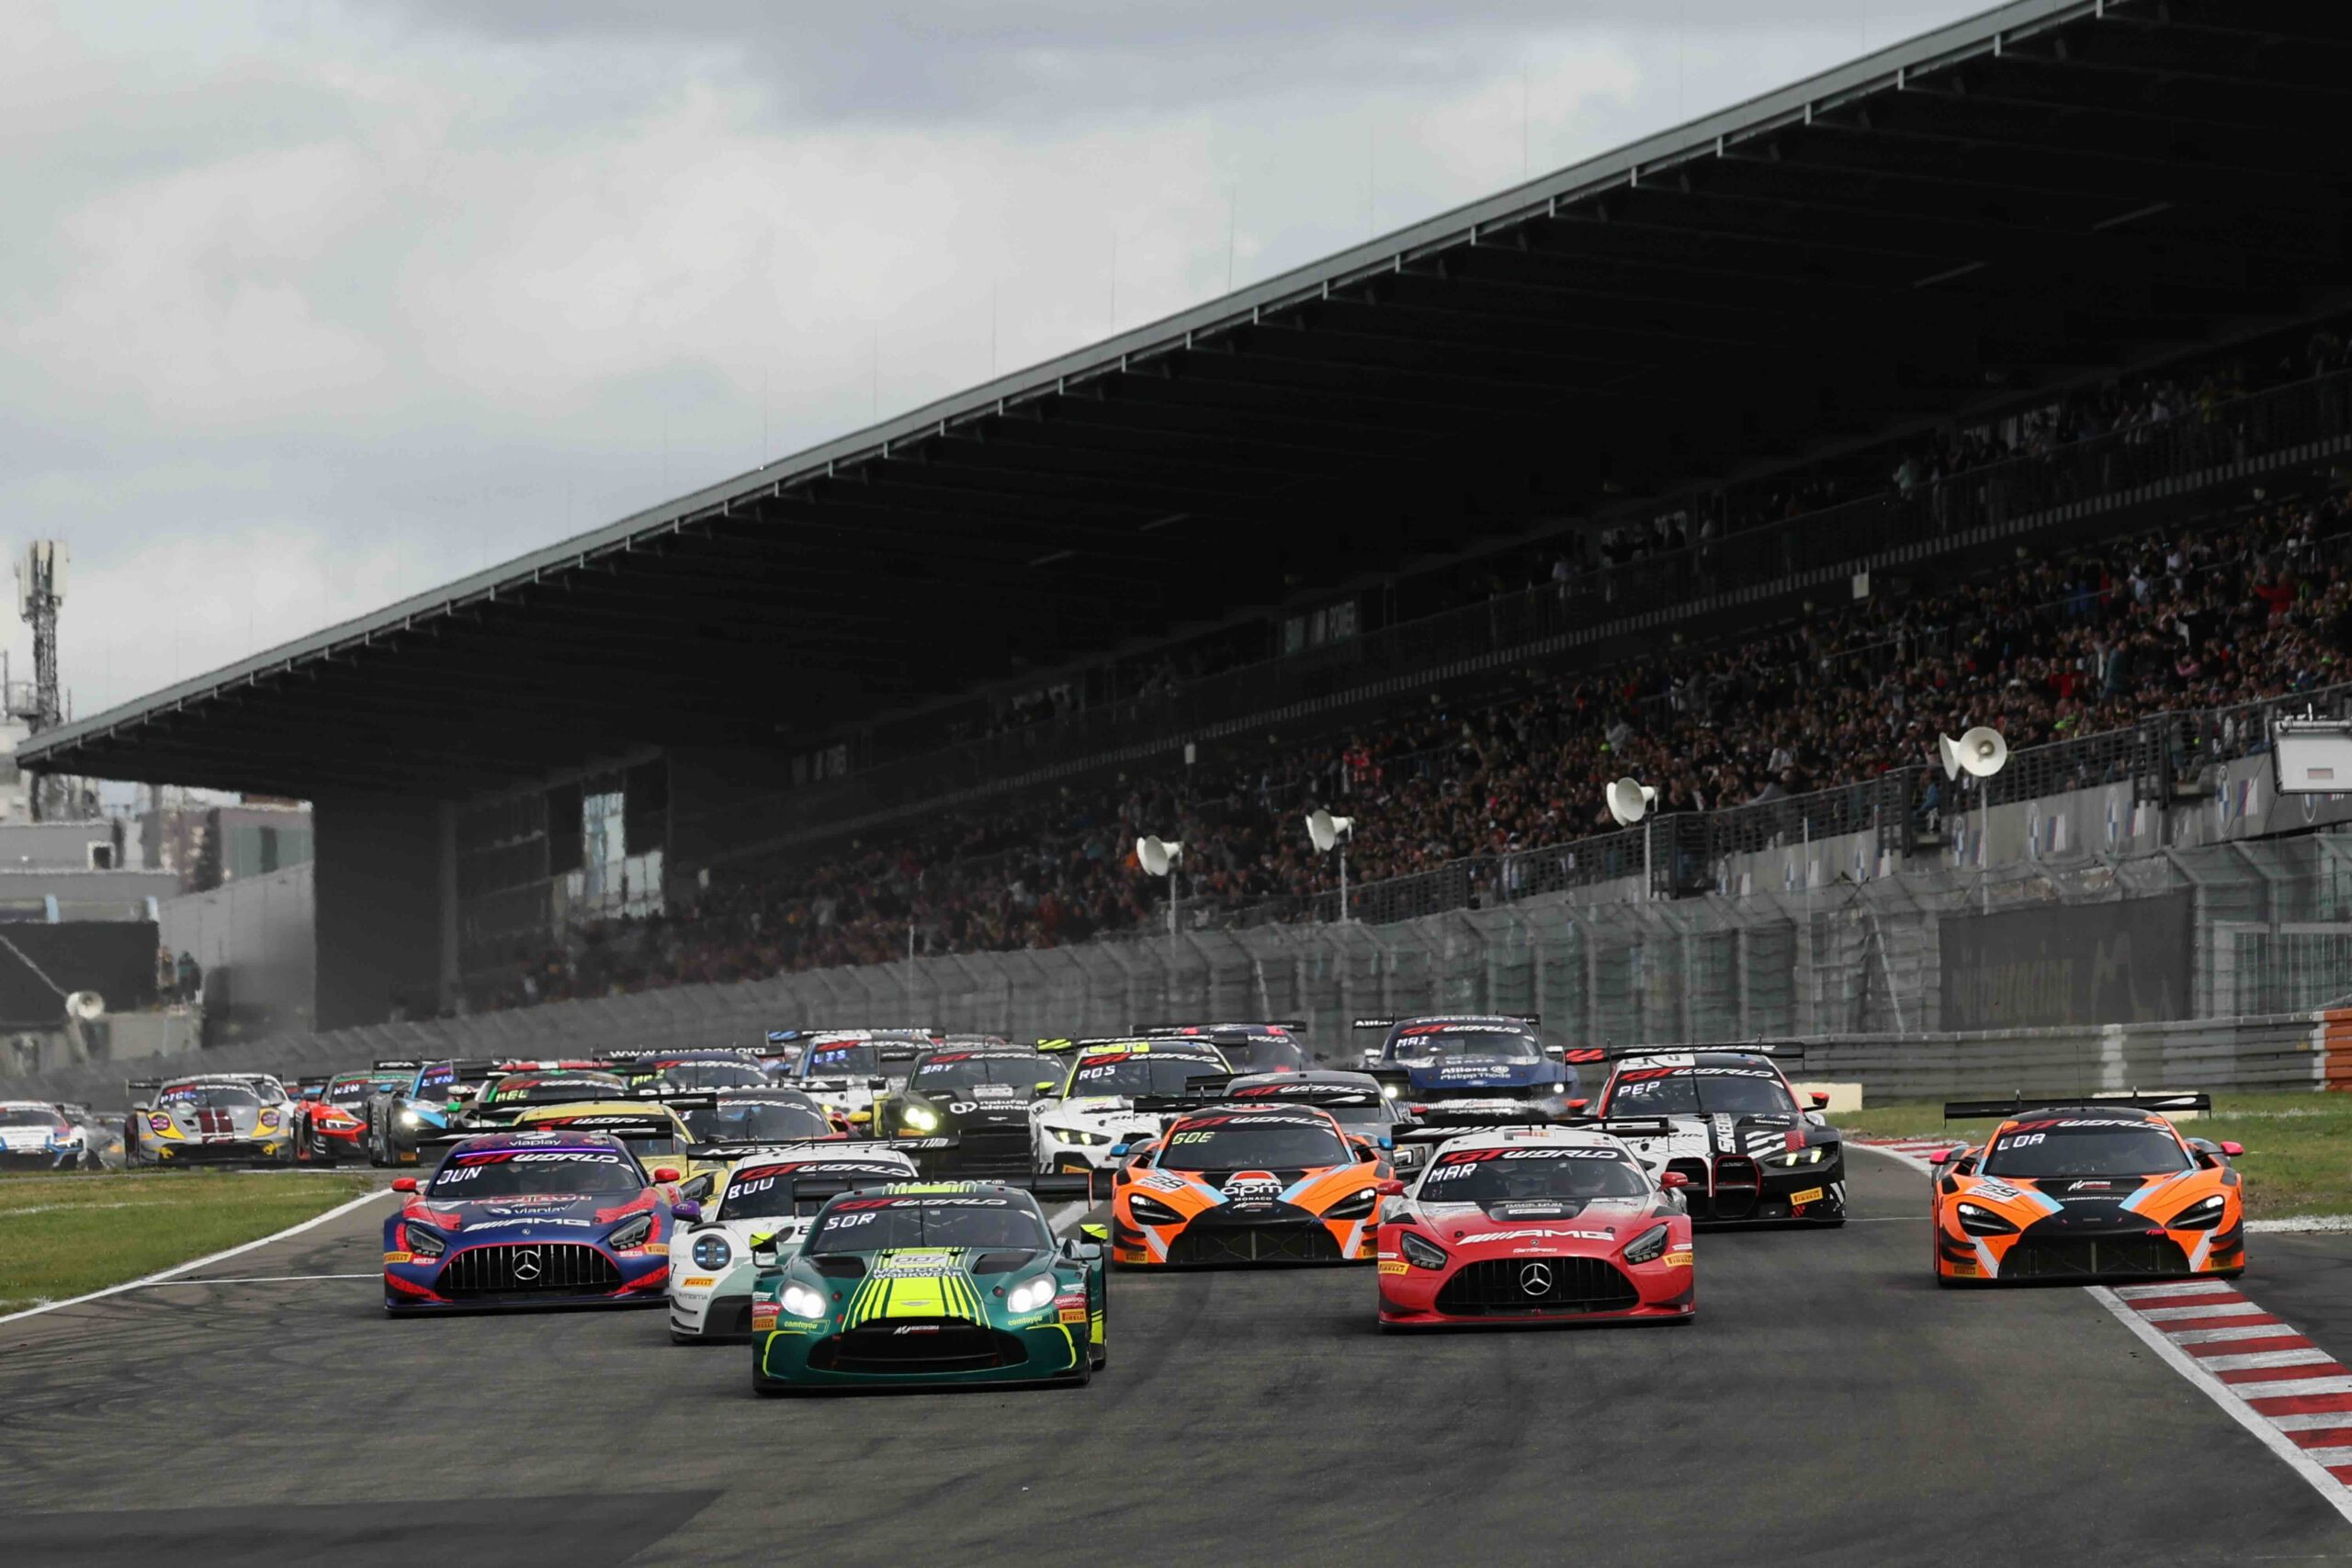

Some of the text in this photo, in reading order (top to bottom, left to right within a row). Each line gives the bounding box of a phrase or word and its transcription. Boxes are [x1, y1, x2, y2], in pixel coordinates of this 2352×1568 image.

[1396, 1036, 1430, 1048] MAI
[1078, 1066, 1116, 1080] ROS
[1671, 1067, 1774, 1077] WORLD
[1618, 1081, 1661, 1097] PEP
[1229, 1116, 1333, 1128] WORLD
[2057, 1119, 2169, 1132] WORLD
[510, 1139, 562, 1148] viaplay
[1171, 1131, 1216, 1145] GOE
[512, 1154, 619, 1164] WORLD
[1502, 1149, 1618, 1159] WORLD
[436, 1166, 482, 1186] JUN
[797, 1163, 910, 1178] WORLD
[1428, 1163, 1477, 1183] MAR
[728, 1176, 775, 1199] BUU
[1220, 1184, 1283, 1197] apm
[823, 1213, 876, 1230] SOR
[784, 1319, 818, 1330] comtoyou
